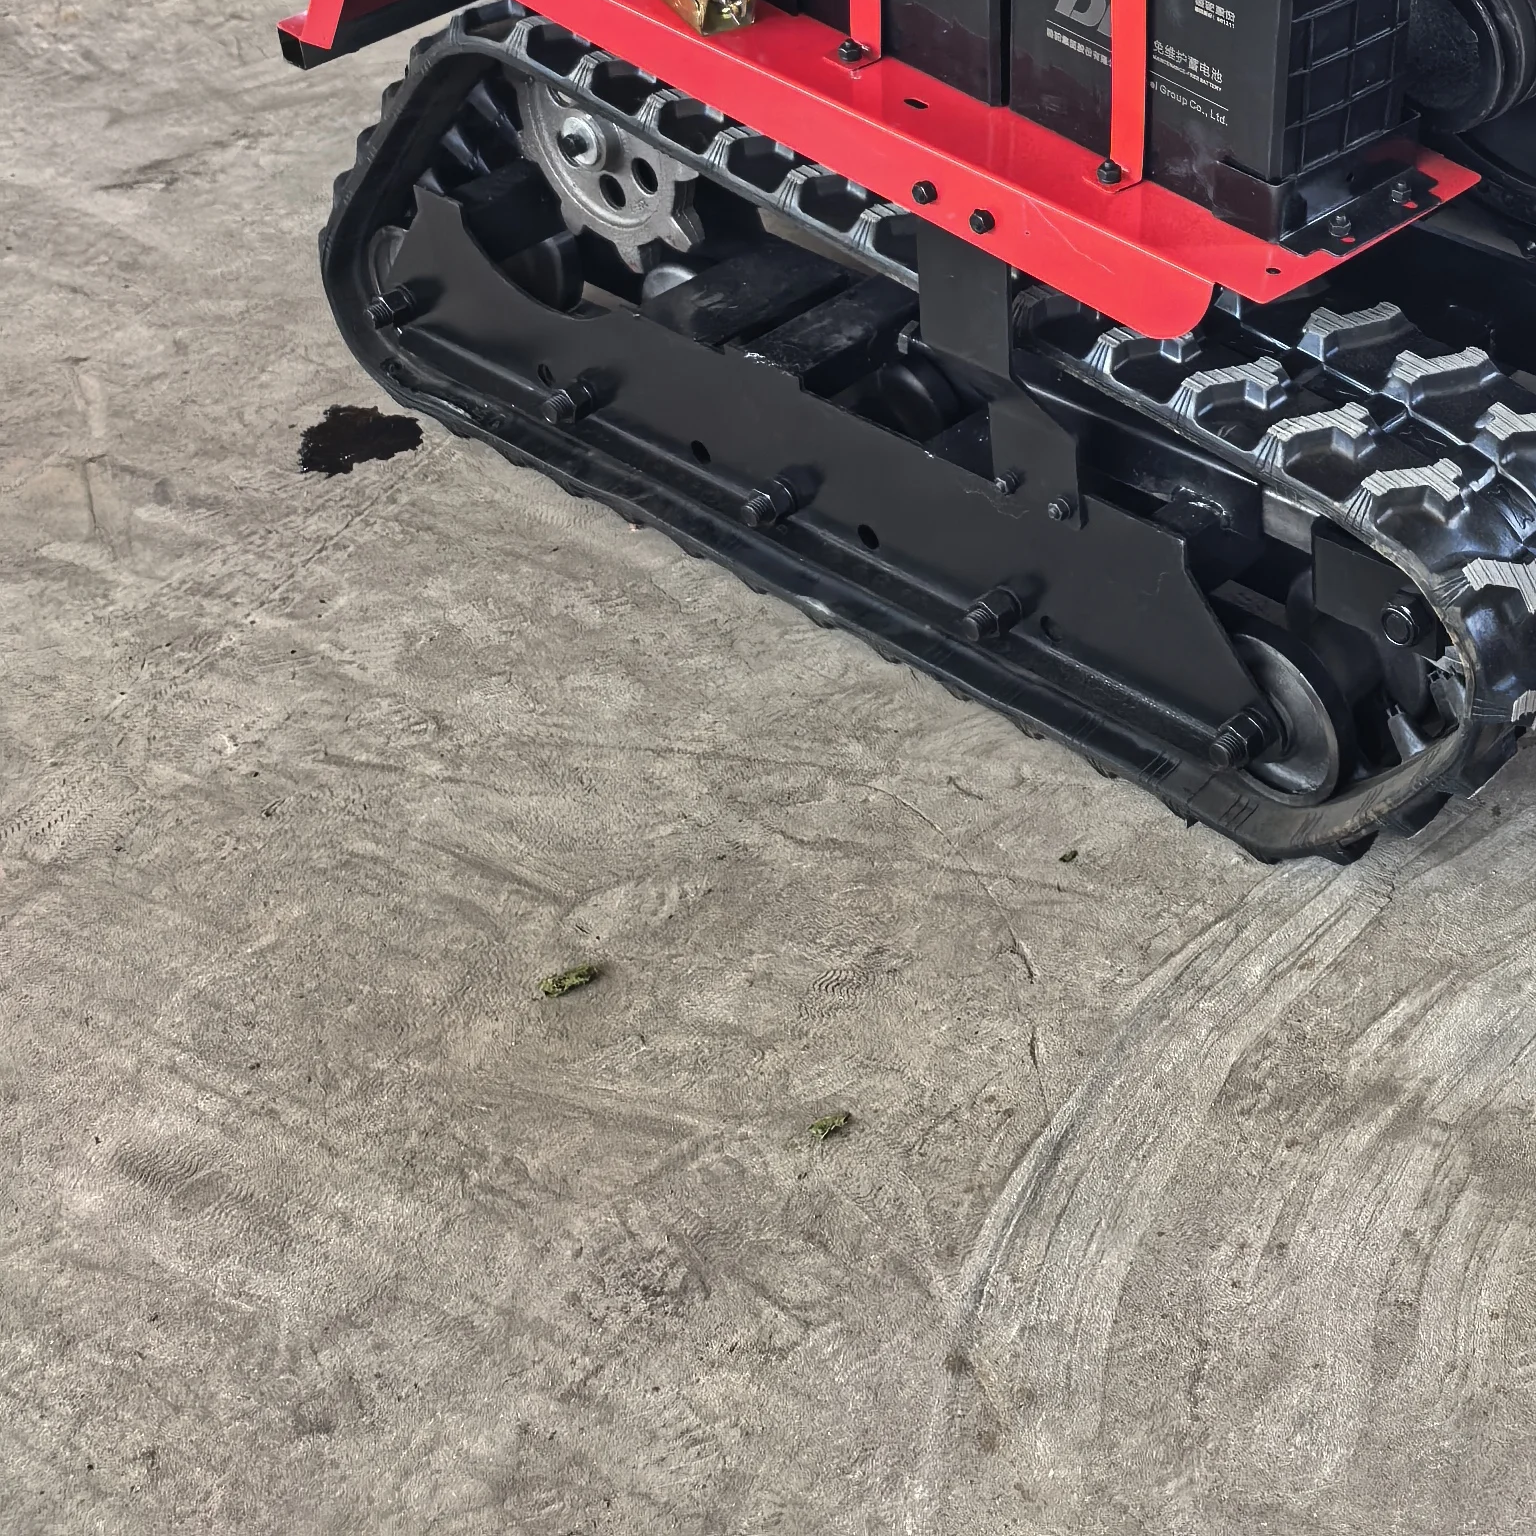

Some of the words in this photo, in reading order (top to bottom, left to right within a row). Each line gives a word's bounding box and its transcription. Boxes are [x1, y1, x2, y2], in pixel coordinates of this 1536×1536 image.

[1153, 39, 1223, 84] 免维护蓄电池
[1159, 84, 1188, 106] Group
[1189, 99, 1208, 117] Co.,
[1210, 109, 1228, 126] Ltd.
